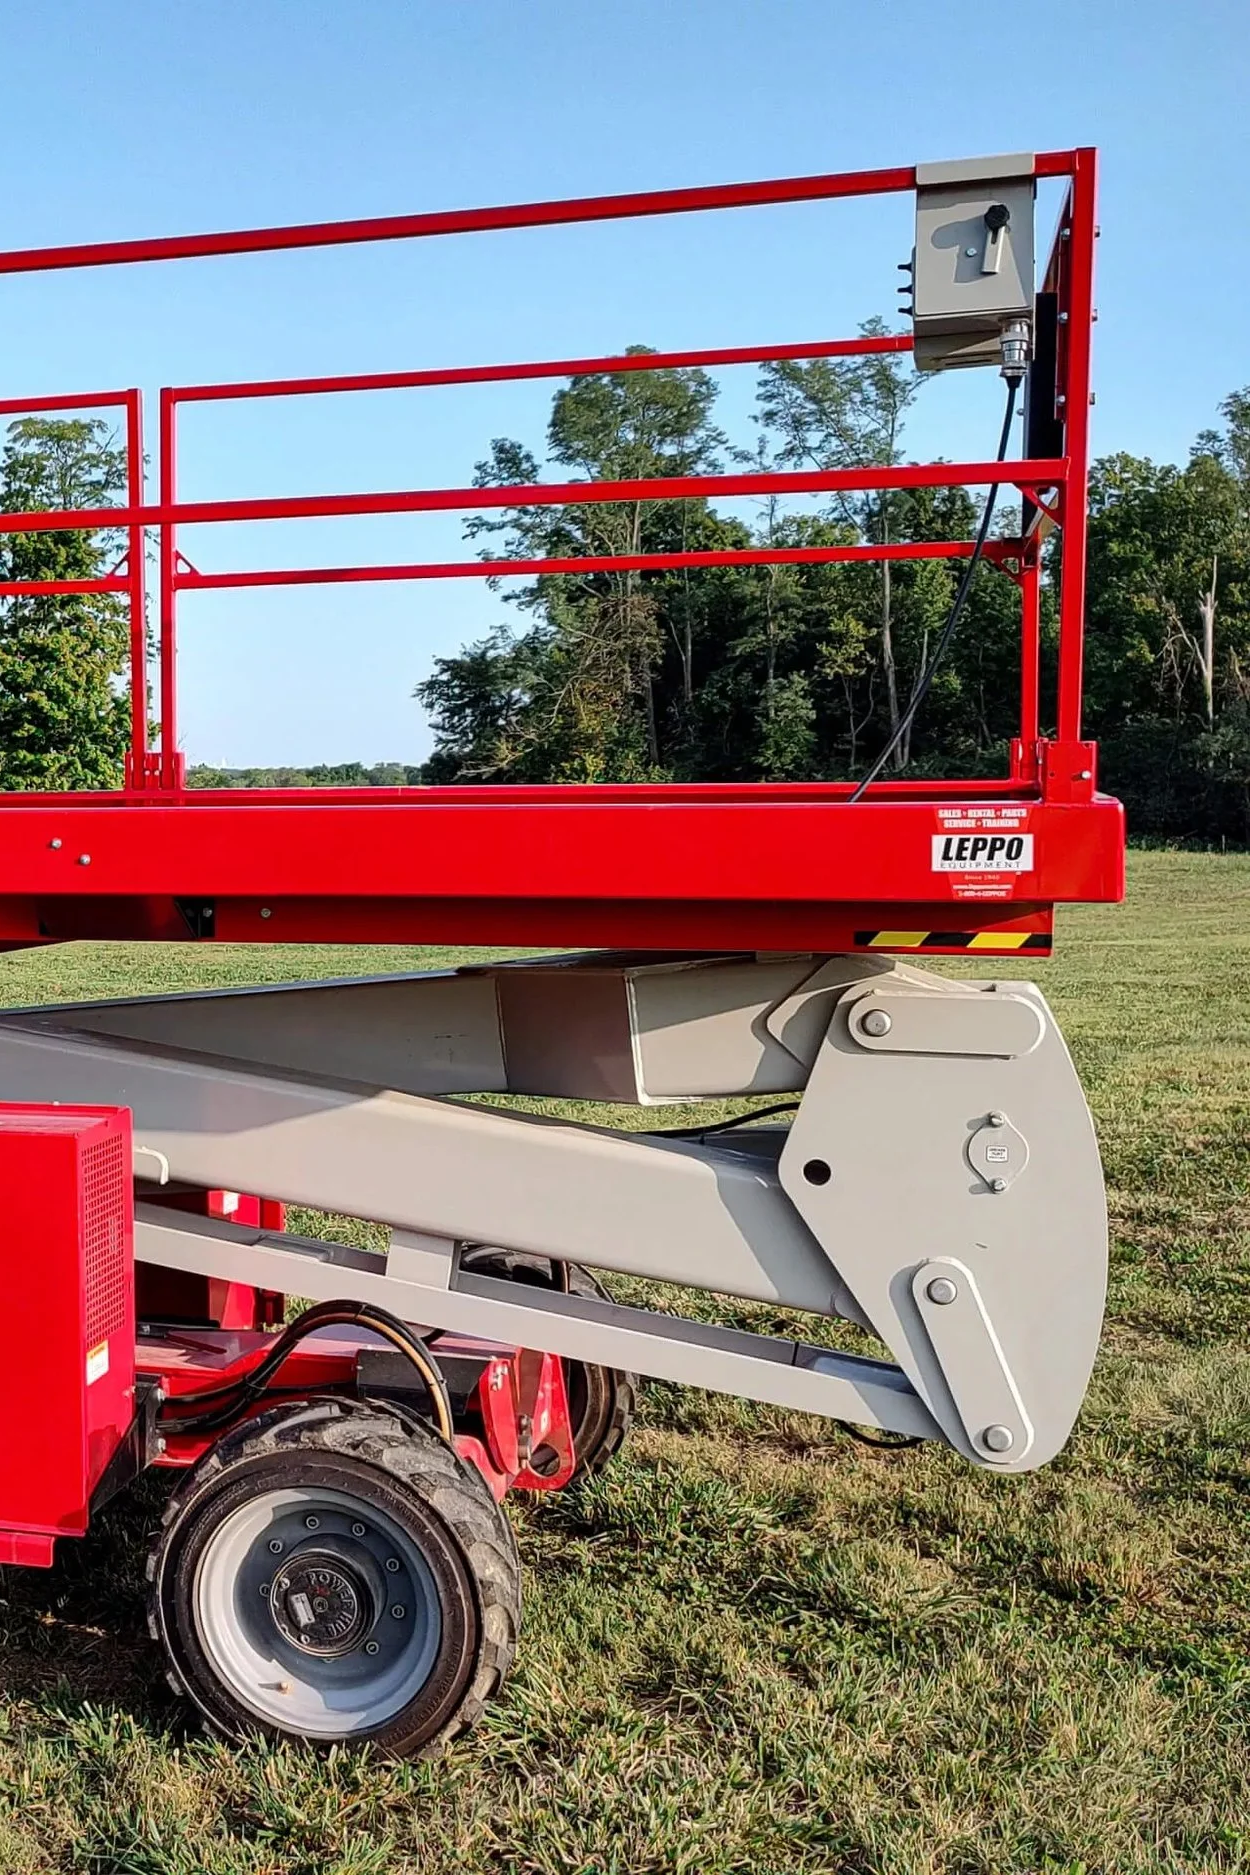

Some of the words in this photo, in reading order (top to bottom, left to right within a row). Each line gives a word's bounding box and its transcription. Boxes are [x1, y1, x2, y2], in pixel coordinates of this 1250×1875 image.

[941, 836, 1024, 862] LEPPO
[939, 861, 1021, 869] EQUIPMENT
[307, 1571, 354, 1609] POWER
